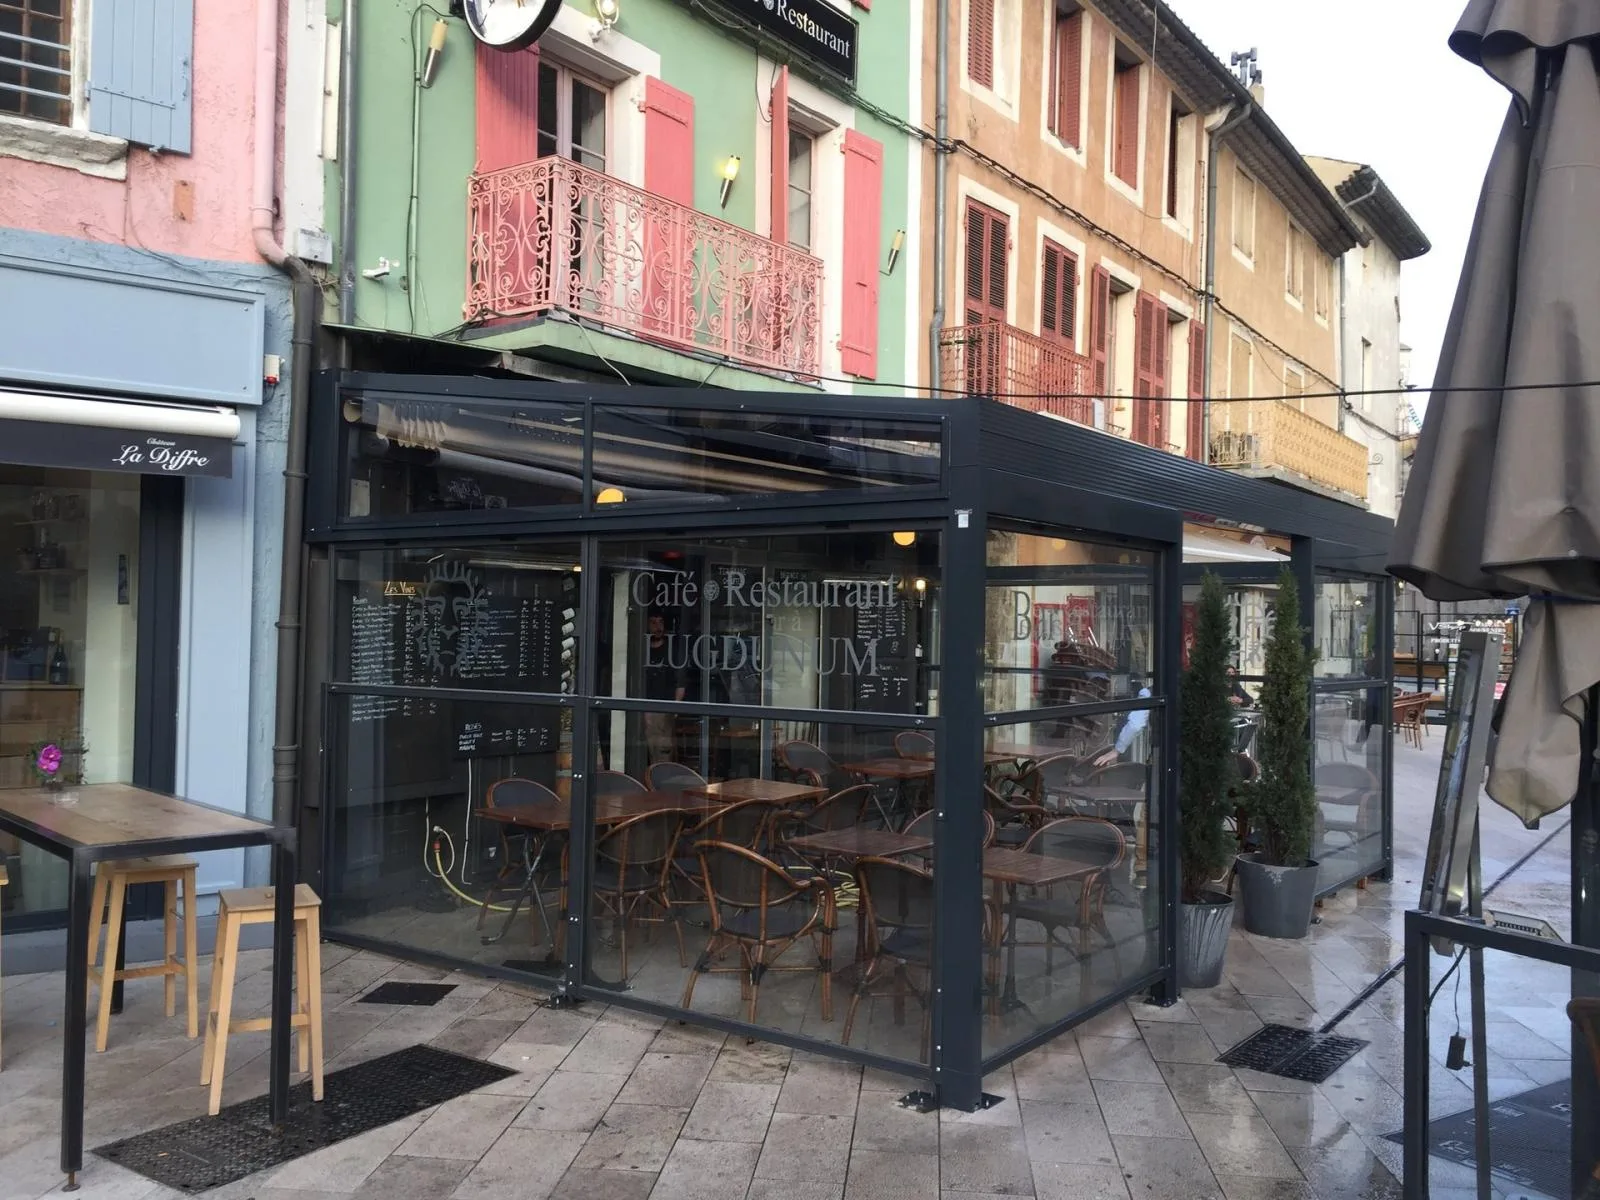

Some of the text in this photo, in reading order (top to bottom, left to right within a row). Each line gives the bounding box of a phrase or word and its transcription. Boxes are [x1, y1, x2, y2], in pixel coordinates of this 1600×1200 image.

[777, 0, 850, 59] Restaurant
[112, 445, 210, 470] La Diffre
[632, 571, 699, 607] Café
[723, 571, 898, 608] Restaurant
[643, 633, 881, 677] LUGDUNUM
